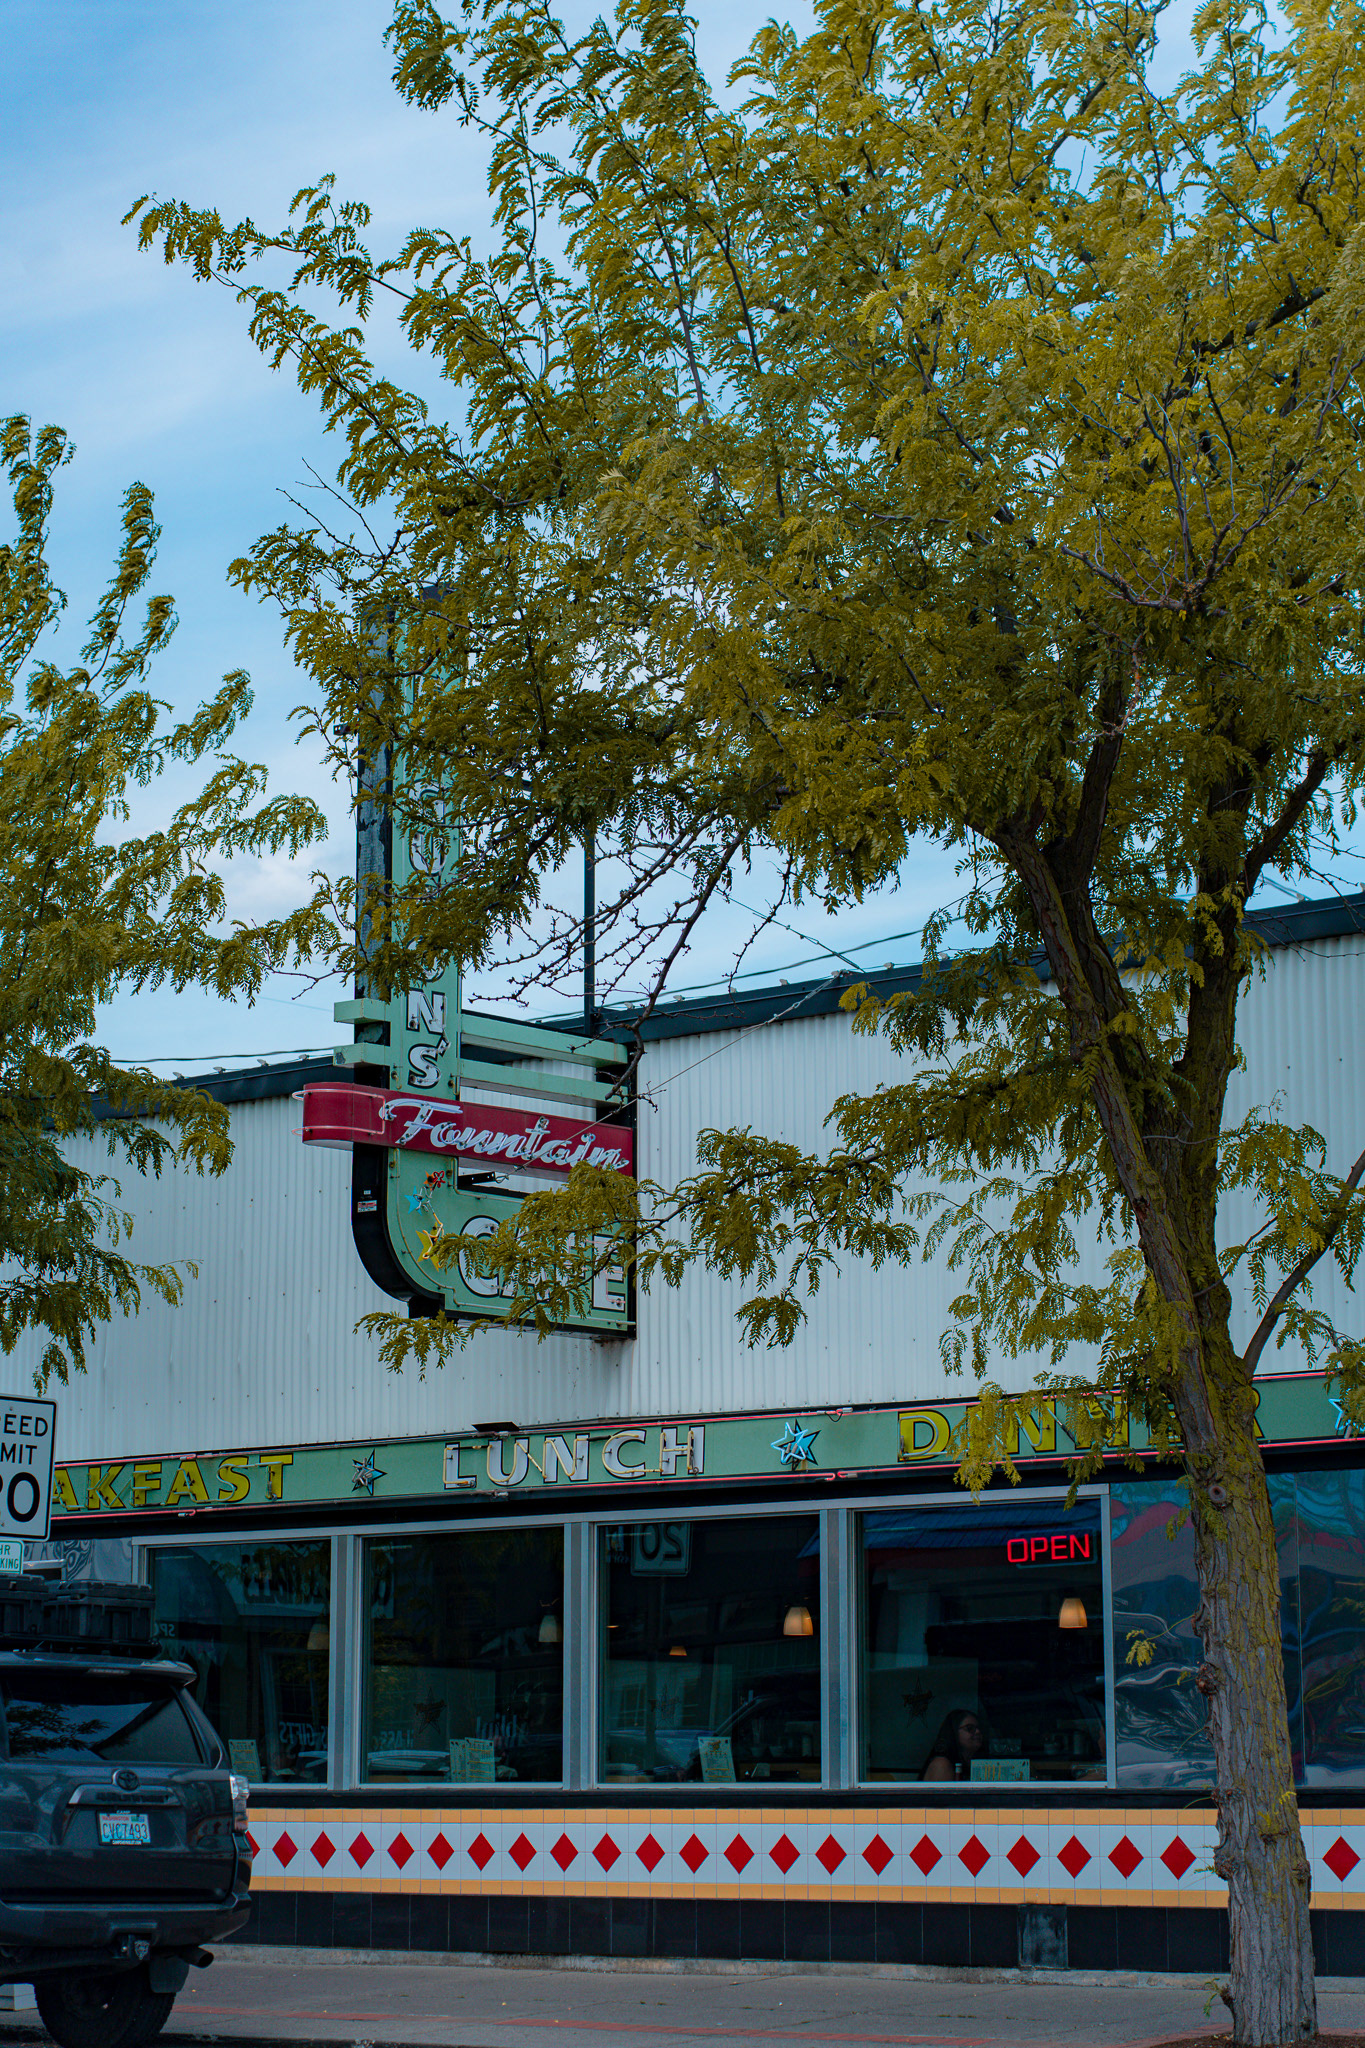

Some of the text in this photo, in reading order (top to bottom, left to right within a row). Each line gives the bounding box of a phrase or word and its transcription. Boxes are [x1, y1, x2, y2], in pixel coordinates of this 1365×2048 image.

[379, 1097, 629, 1170] Fountain
[0, 1413, 48, 1437] EED
[443, 1424, 706, 1490] LUNCH
[0, 1471, 41, 1523] 0
[1006, 1533, 1091, 1564] OPEN
[102, 1822, 148, 1839] CVC7493
